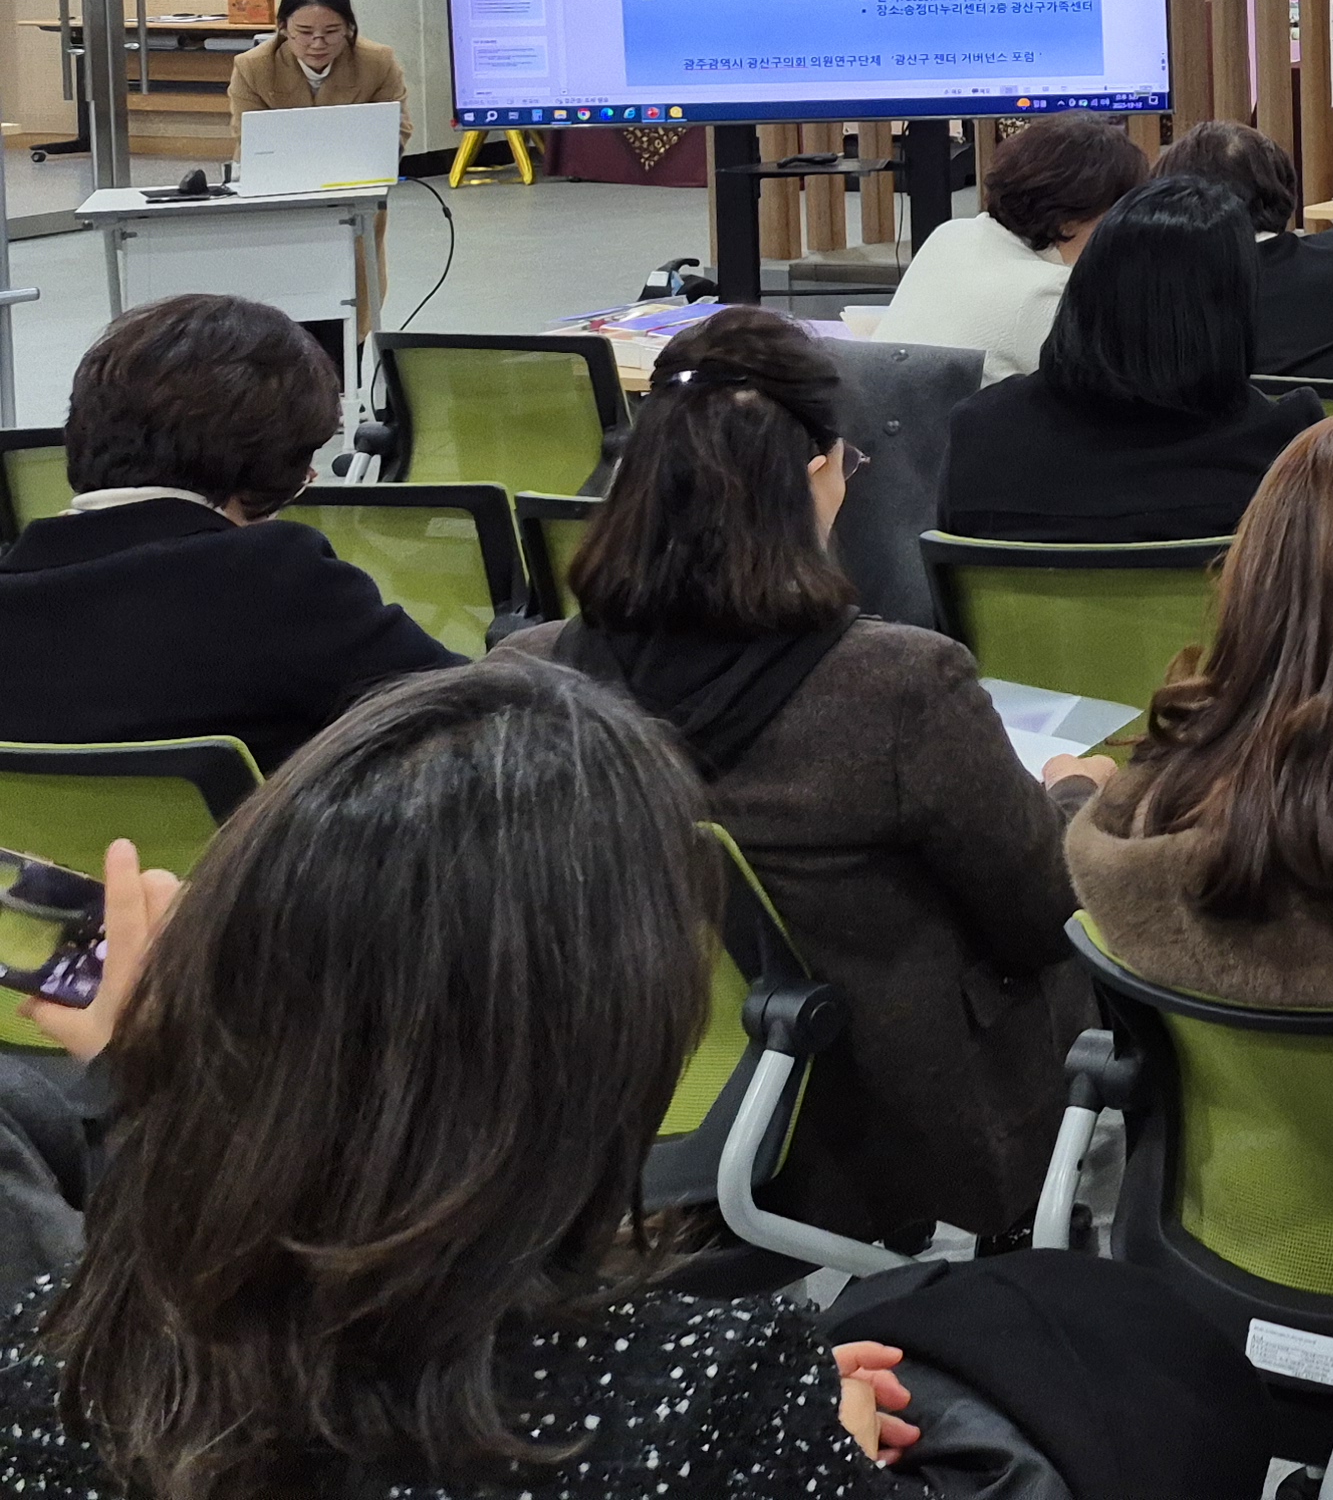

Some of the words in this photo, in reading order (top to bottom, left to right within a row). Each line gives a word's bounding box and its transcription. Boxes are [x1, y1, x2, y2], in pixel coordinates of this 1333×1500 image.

[1011, 0, 1093, 14] 광산구가족센터
[683, 56, 743, 71] 광주광역시
[748, 55, 808, 69] 광산구의회
[810, 54, 882, 68] 의원연구단체
[933, 52, 957, 65] 젠더
[961, 51, 1008, 64] 거버넌스
